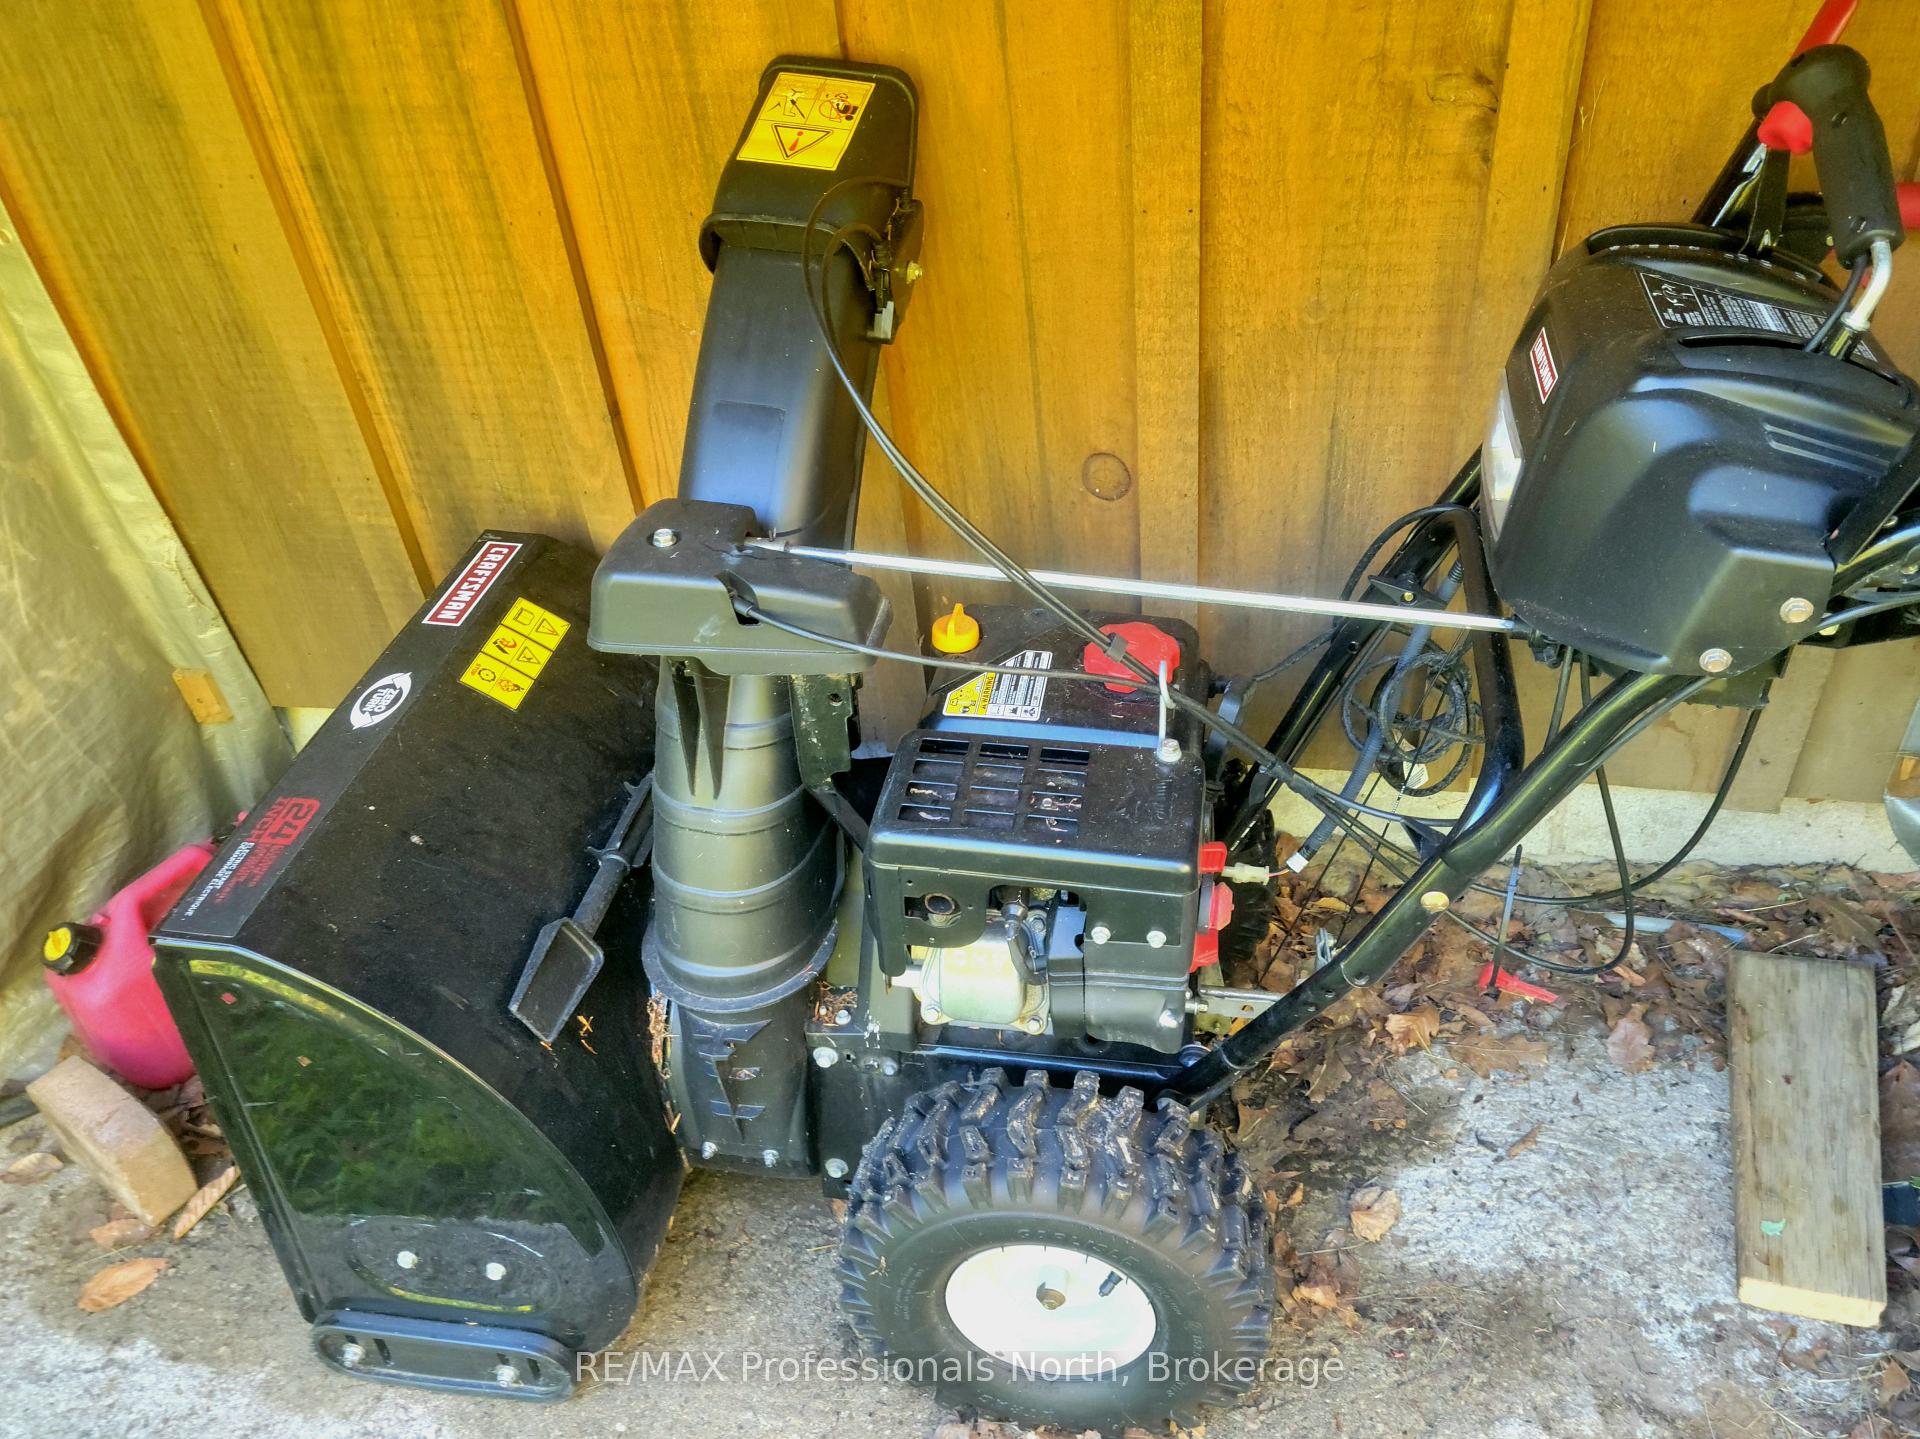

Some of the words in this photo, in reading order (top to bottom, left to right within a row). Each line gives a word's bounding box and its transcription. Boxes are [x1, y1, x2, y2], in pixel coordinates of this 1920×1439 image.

[437, 547, 509, 620] CRAFTSMAN
[373, 688, 400, 712] ZERO
[982, 675, 994, 702] WARNING
[267, 802, 311, 839] 24
